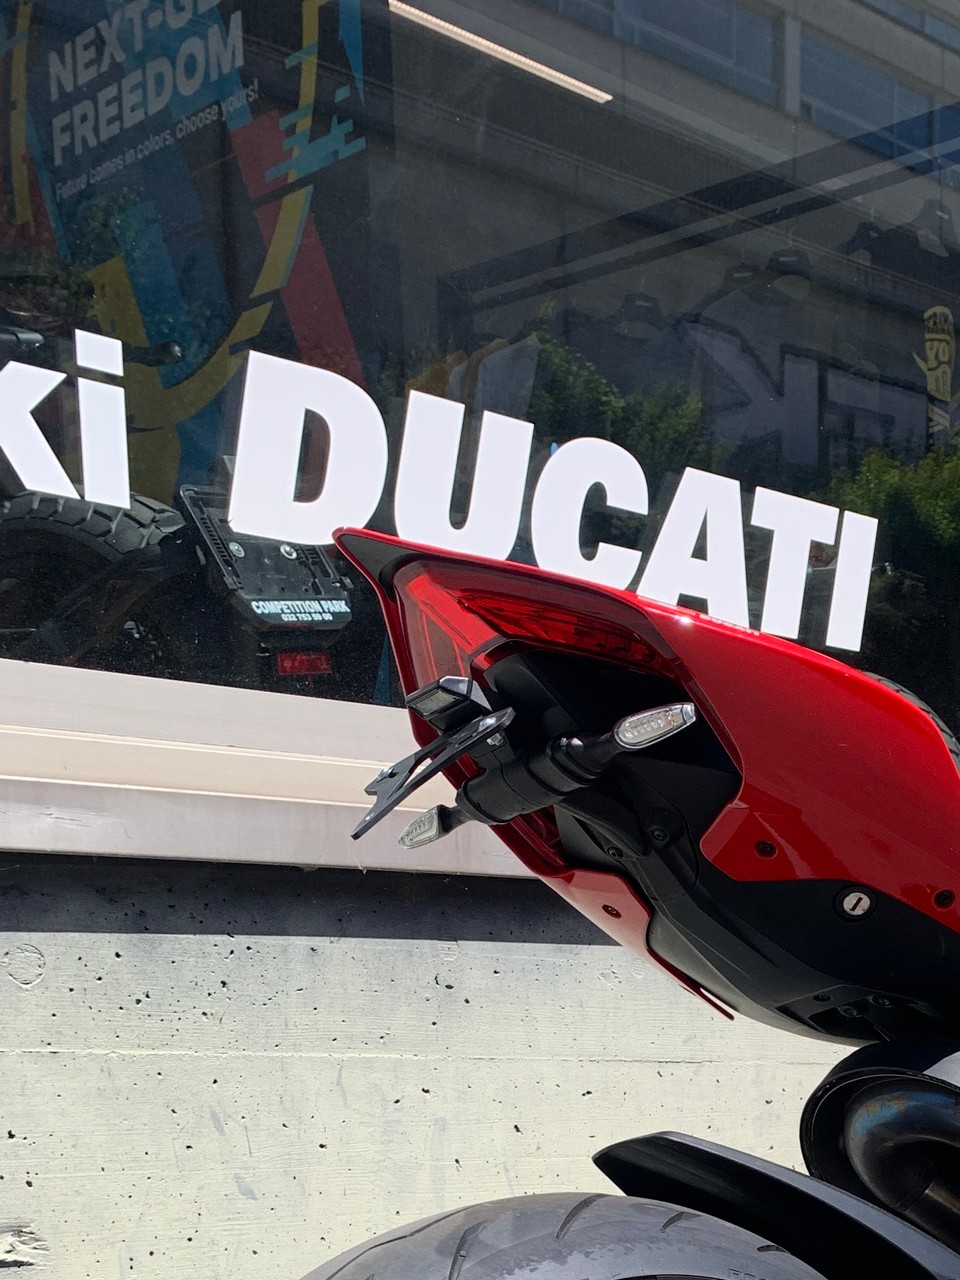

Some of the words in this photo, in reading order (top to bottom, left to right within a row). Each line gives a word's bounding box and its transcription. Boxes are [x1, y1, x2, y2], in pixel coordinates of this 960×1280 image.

[50, 0, 222, 101] NEXT-G
[52, 10, 244, 167] FREEDOM
[90, 154, 124, 182] comes
[125, 147, 135, 166] in
[137, 131, 175, 160] colors,
[176, 107, 218, 140] choose
[221, 78, 259, 121] yours!
[227, 350, 878, 651] DUCATI
[251, 601, 323, 613] COMPETITION
[320, 600, 351, 612] PARK
